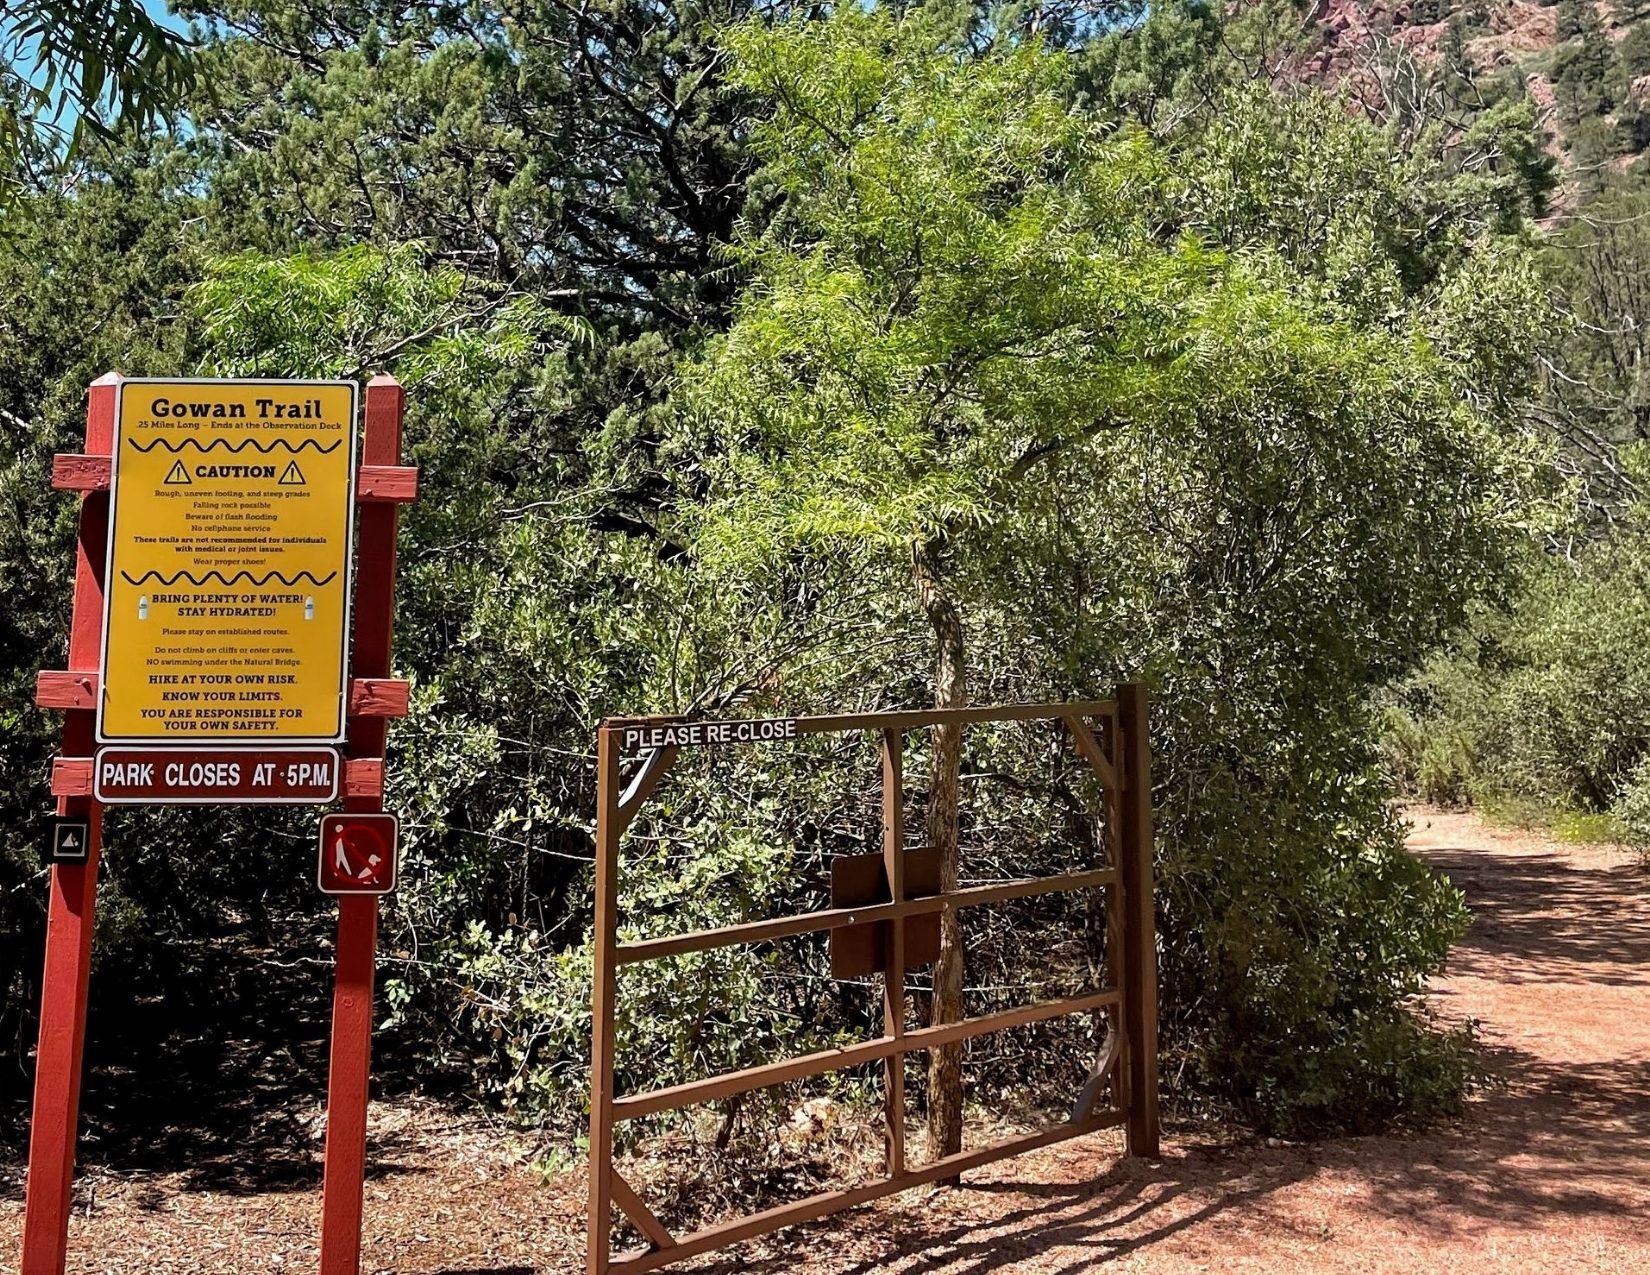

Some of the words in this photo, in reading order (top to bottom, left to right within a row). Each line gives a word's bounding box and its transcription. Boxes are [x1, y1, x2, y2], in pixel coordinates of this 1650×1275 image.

[151, 398, 246, 418] Gowan
[256, 400, 322, 419] Trail
[177, 422, 200, 430] Long
[263, 422, 317, 430] Observation
[196, 466, 276, 478] CAUTION
[152, 595, 189, 603] BRING
[194, 595, 238, 603] PLENTY
[241, 595, 256, 603] OF
[259, 595, 303, 603] WATER!
[178, 608, 206, 616] STAY
[210, 608, 276, 616] HYDRATED!
[149, 675, 178, 684] HIKE
[181, 675, 196, 684] AT
[199, 675, 232, 684] YOUR
[235, 675, 264, 684] OWN
[267, 675, 298, 684] RISK.
[162, 692, 201, 701] KNOW
[203, 692, 236, 701] YOUR
[239, 692, 283, 701] LIMITS.
[141, 709, 166, 718] YOU
[169, 709, 192, 718] ARE
[195, 709, 276, 718] RESPONSIBLE
[279, 709, 302, 718] FOR
[164, 721, 196, 730] YOUR
[200, 721, 229, 730] OWN
[233, 721, 278, 730] SAFETY.
[626, 726, 701, 748] PLEASE
[707, 720, 796, 743] RE-CLOSE
[103, 763, 152, 786] PARK
[165, 763, 240, 786] CLOSES
[252, 763, 276, 786] AT
[287, 763, 330, 786] 5P.M.
